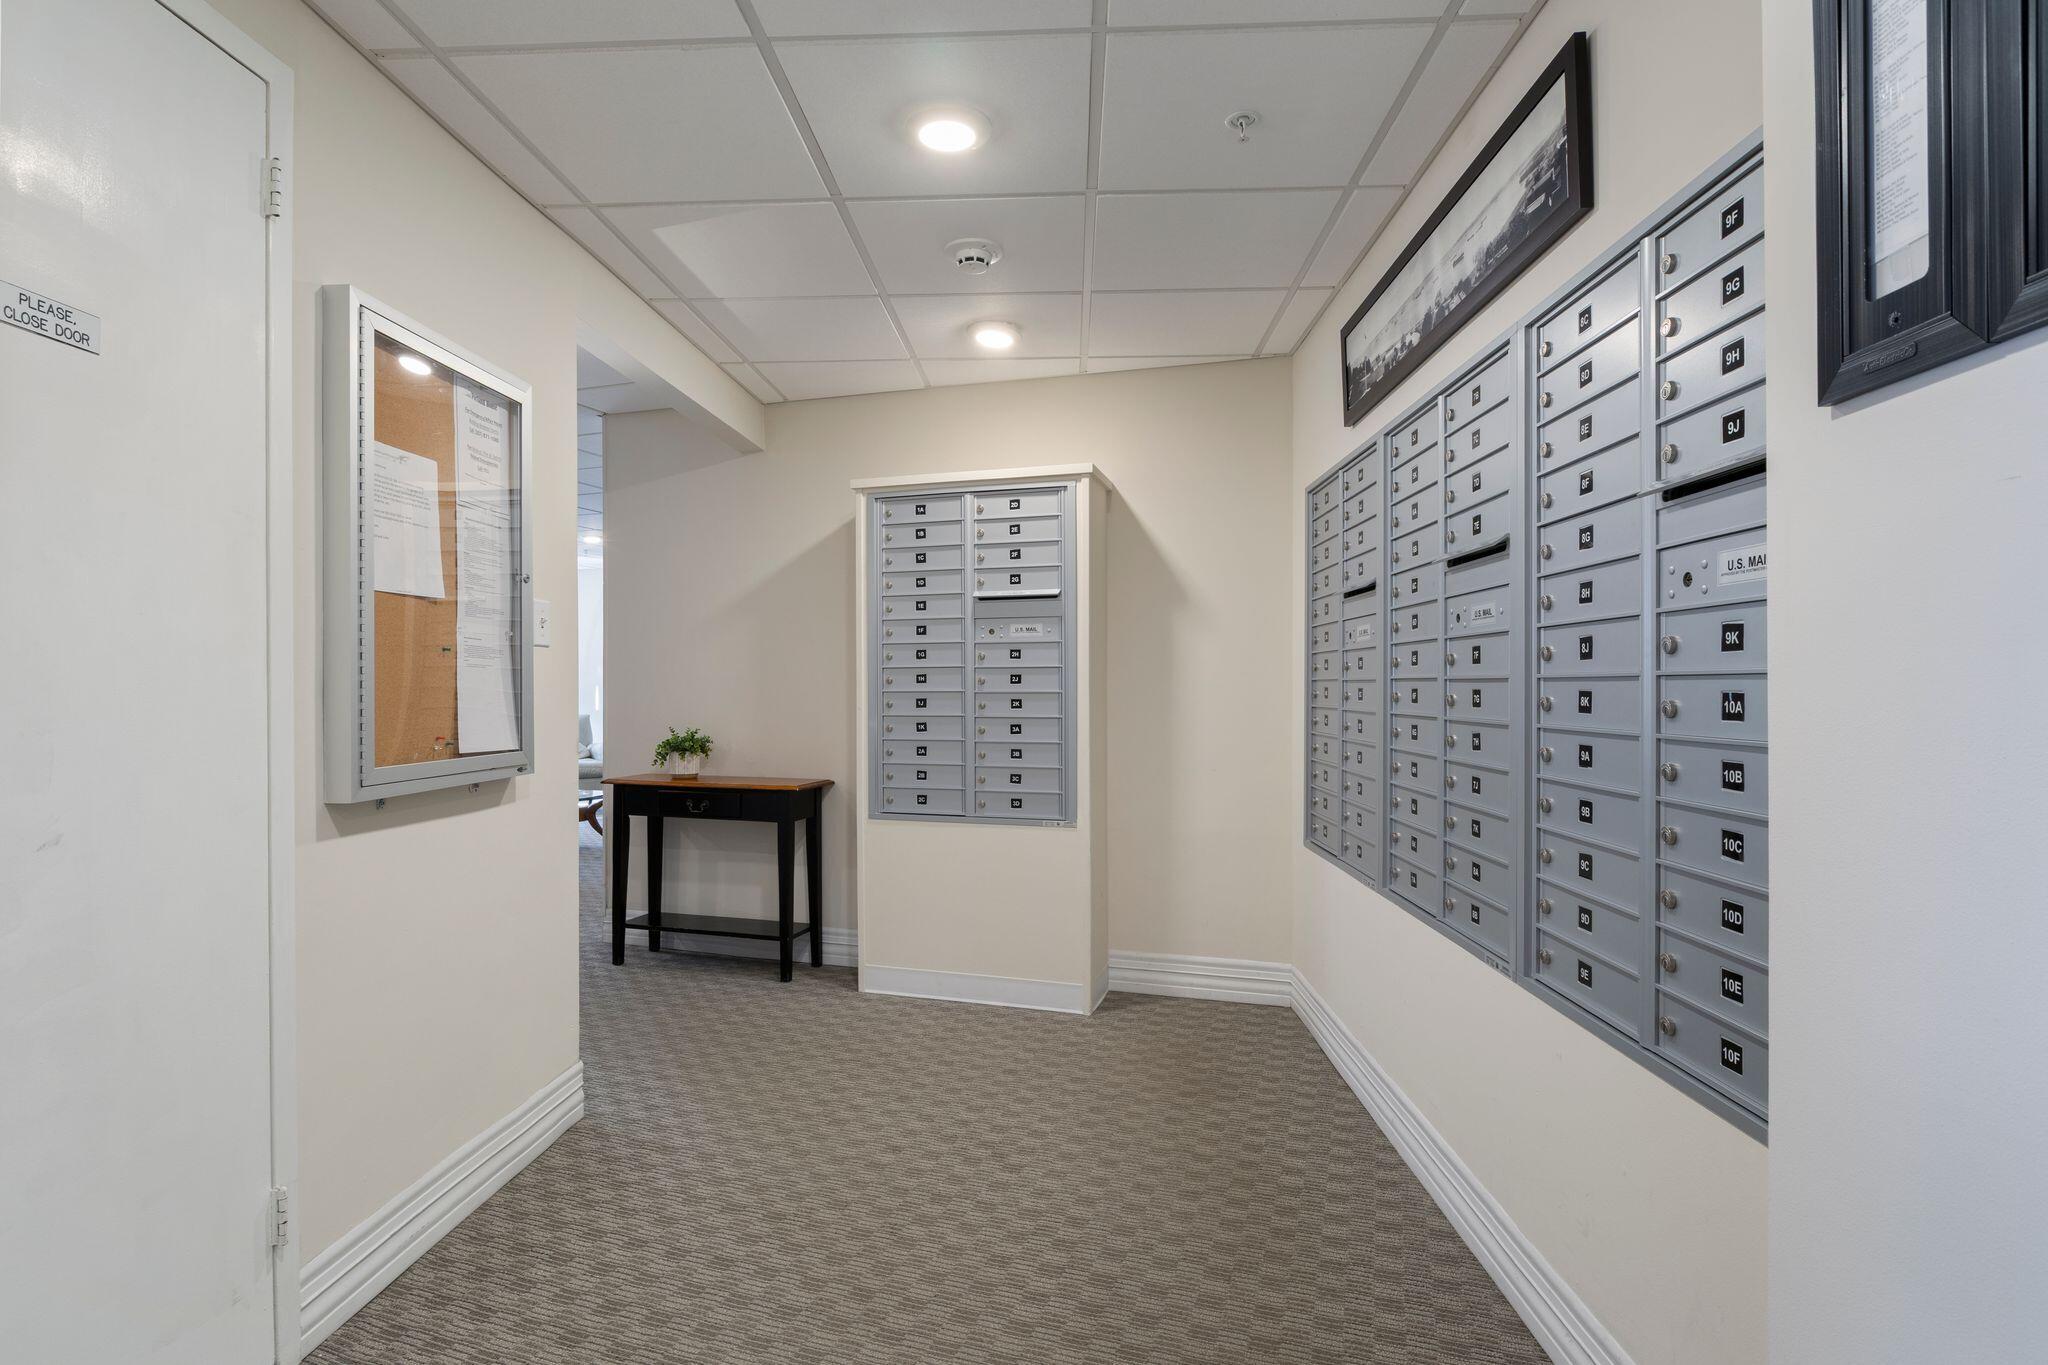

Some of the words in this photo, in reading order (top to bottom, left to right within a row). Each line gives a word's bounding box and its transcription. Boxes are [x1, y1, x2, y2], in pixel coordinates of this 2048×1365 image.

[1724, 208, 1738, 229] 9F
[1725, 276, 1740, 296] 9G
[3, 305, 48, 332] CLOSE
[55, 323, 90, 346] DOOR
[1579, 313, 1589, 328] 8C
[1725, 347, 1740, 366] 9H
[1580, 368, 1590, 382] 8D
[1580, 422, 1590, 436] 8E
[1727, 418, 1740, 435] 9J
[1581, 478, 1590, 490] 8F
[1580, 531, 1591, 544] 8G
[1727, 558, 1746, 571] U.S.
[1748, 554, 1766, 568] MAI
[1580, 587, 1591, 599] 8H
[1724, 630, 1740, 645] 9K
[1580, 642, 1590, 654] 8J
[1579, 695, 1590, 707] 8K
[1723, 700, 1743, 714] 10A
[1580, 749, 1590, 762] 9A
[1722, 769, 1743, 784] 10B
[1580, 805, 1591, 818] 9B
[1722, 837, 1743, 854] 10C
[1580, 859, 1590, 872] 9C
[1580, 912, 1590, 925] 9D
[1722, 907, 1742, 925] 10D
[1579, 967, 1589, 981] 9E
[1722, 976, 1742, 996] 10E
[1722, 1046, 1741, 1065] 10F
